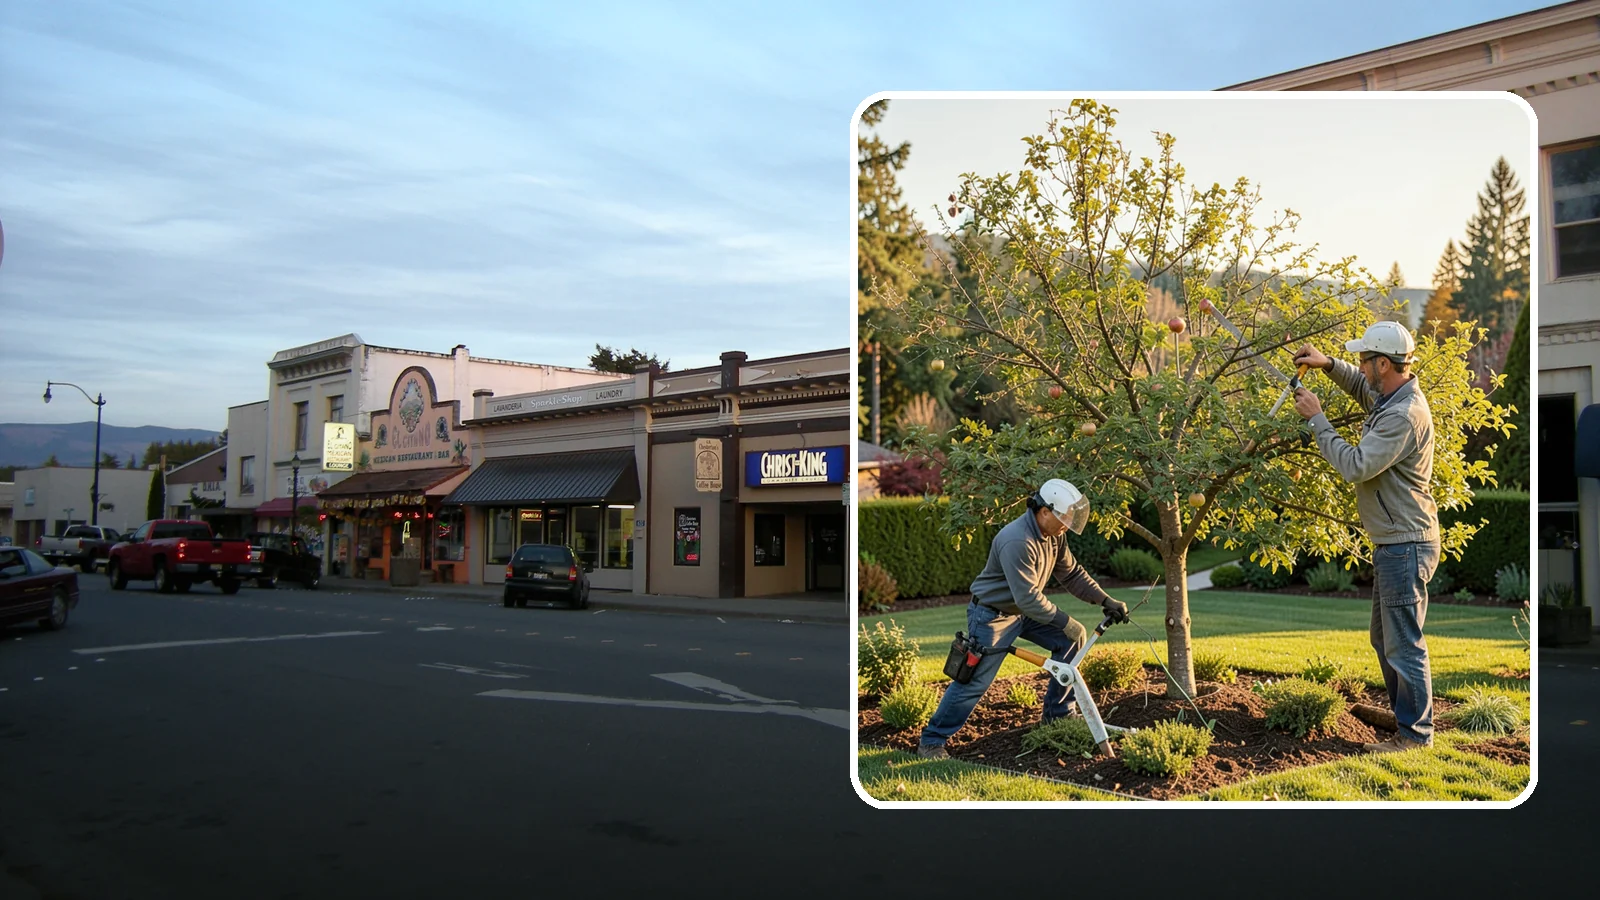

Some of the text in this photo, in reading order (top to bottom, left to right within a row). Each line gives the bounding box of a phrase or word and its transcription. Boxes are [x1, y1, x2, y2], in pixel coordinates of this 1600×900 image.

[562, 395, 583, 404] Shop
[595, 389, 624, 400] LAUNDRY
[493, 402, 523, 412] LAVANDERIA
[373, 455, 396, 464] MEXICAN
[397, 451, 433, 462] RESTAURANT
[437, 450, 450, 459] BAR
[761, 450, 827, 478] CHRIST KING
